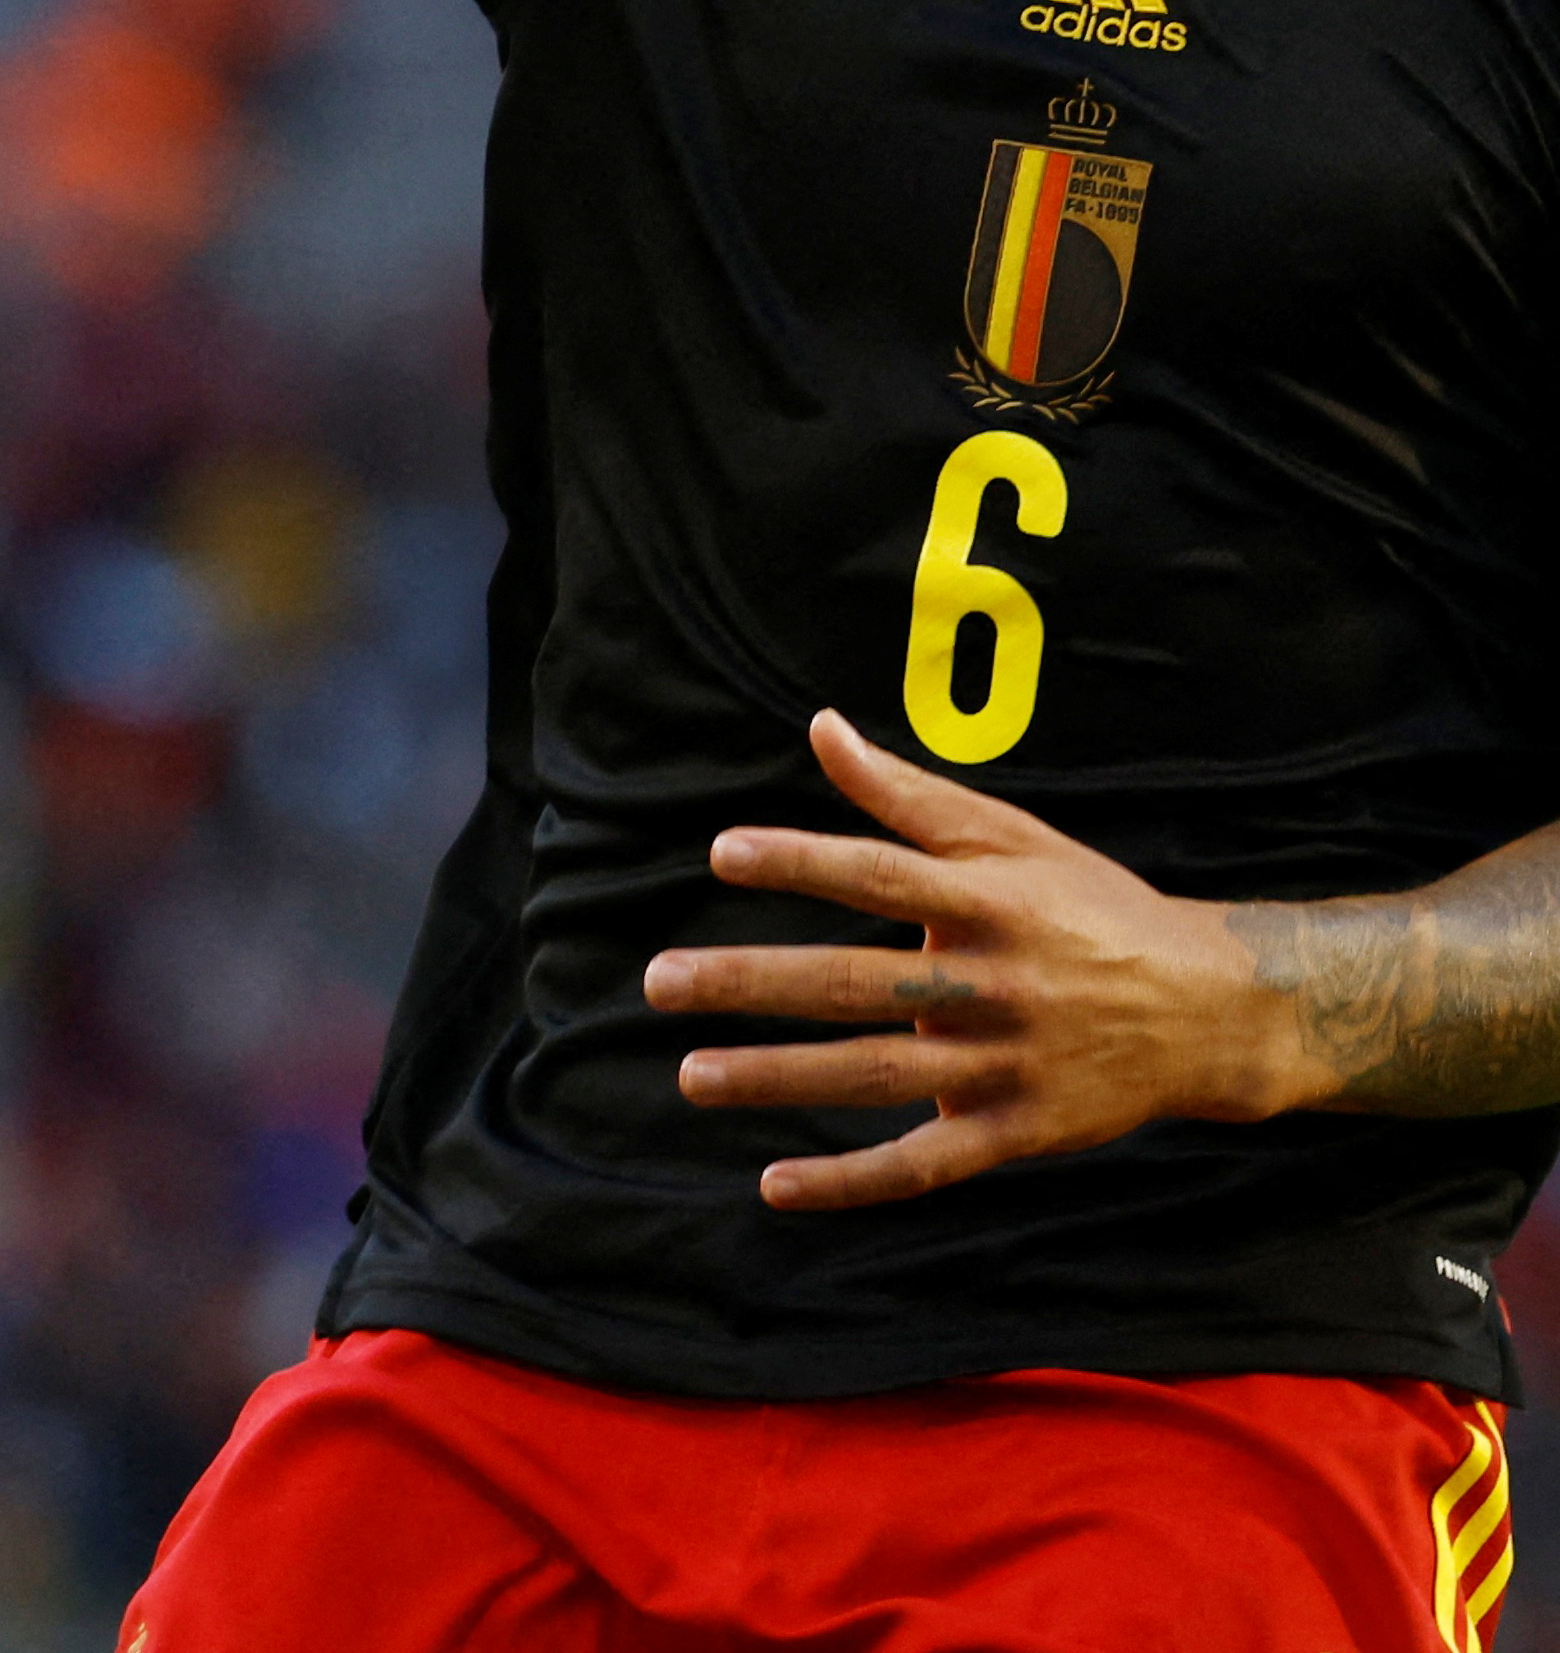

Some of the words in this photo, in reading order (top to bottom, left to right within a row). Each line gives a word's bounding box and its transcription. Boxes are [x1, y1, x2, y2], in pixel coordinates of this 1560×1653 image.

[1020, 3, 1188, 52] adidas
[1073, 158, 1128, 182] ROYAL
[1068, 177, 1145, 204] BELGIAN
[903, 429, 1069, 765] 6
